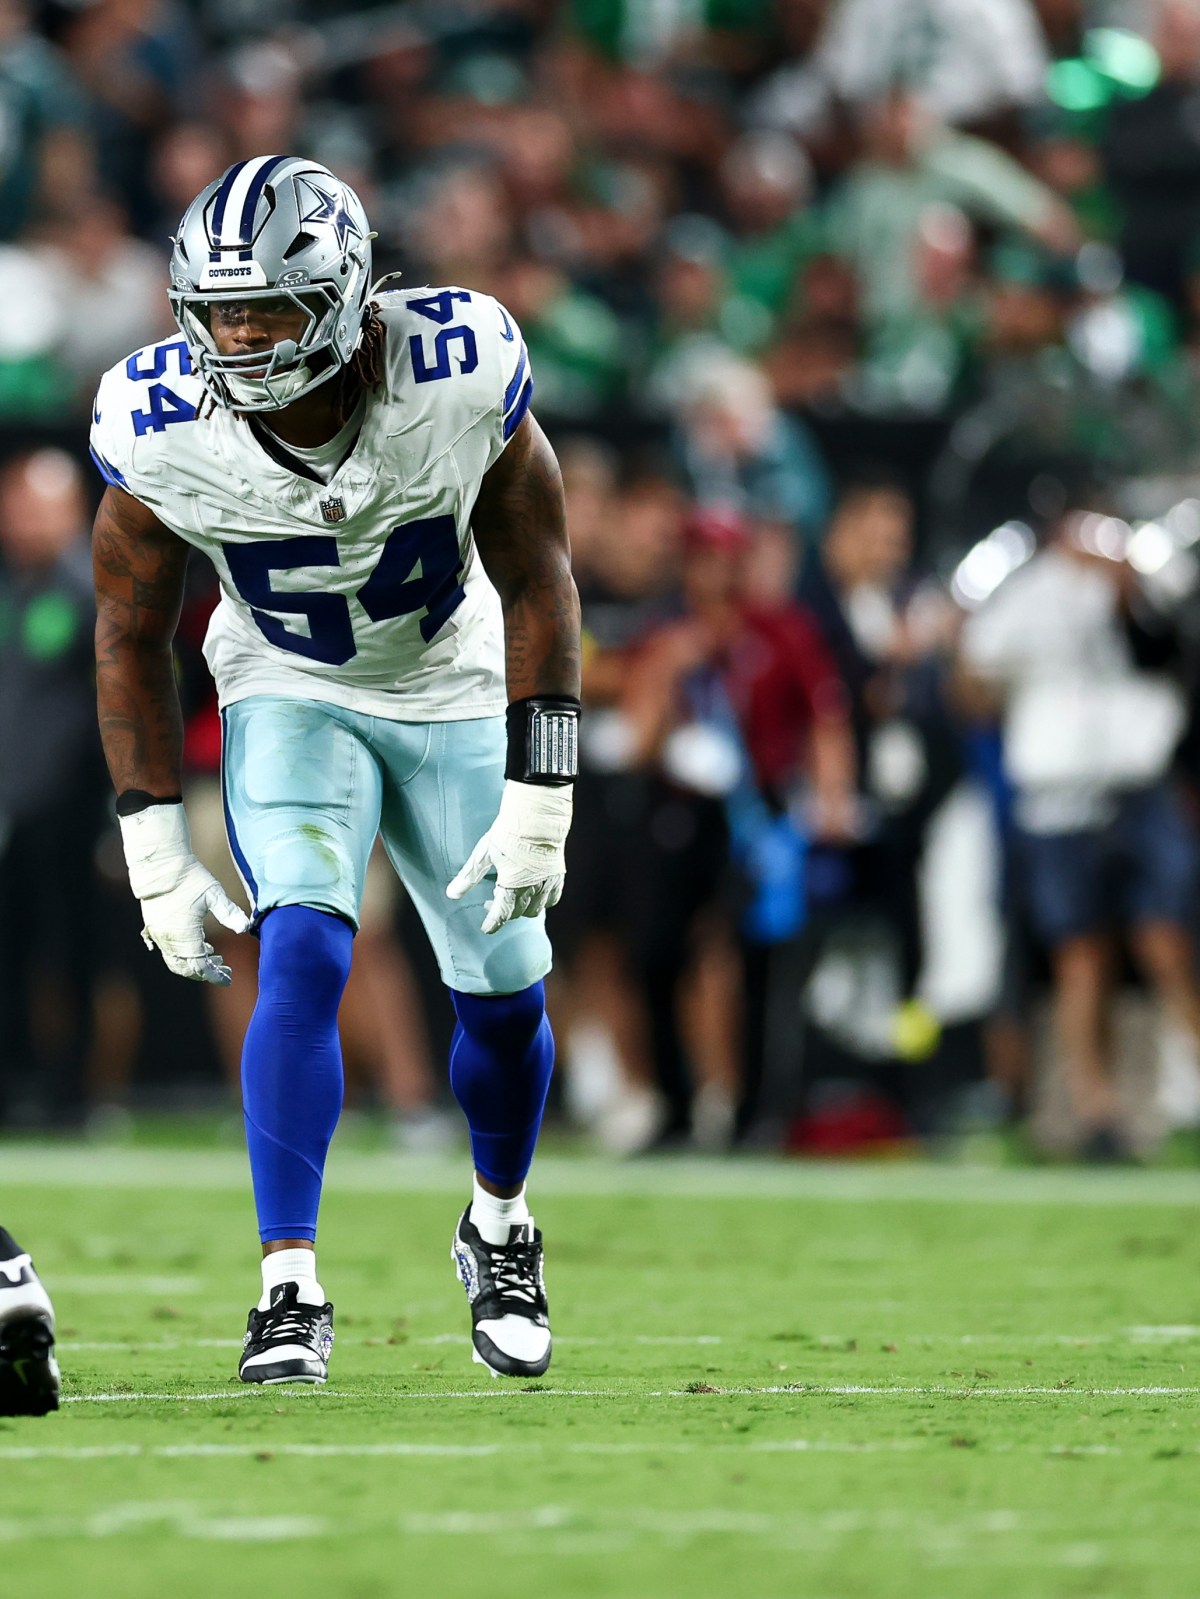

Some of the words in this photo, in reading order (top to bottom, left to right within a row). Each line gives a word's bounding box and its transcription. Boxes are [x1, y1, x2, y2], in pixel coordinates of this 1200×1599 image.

[209, 267, 252, 277] COWBOYS
[279, 277, 308, 287] OAKLEY
[406, 290, 479, 384] 54
[126, 341, 197, 437] 54
[221, 514, 467, 666] 54
